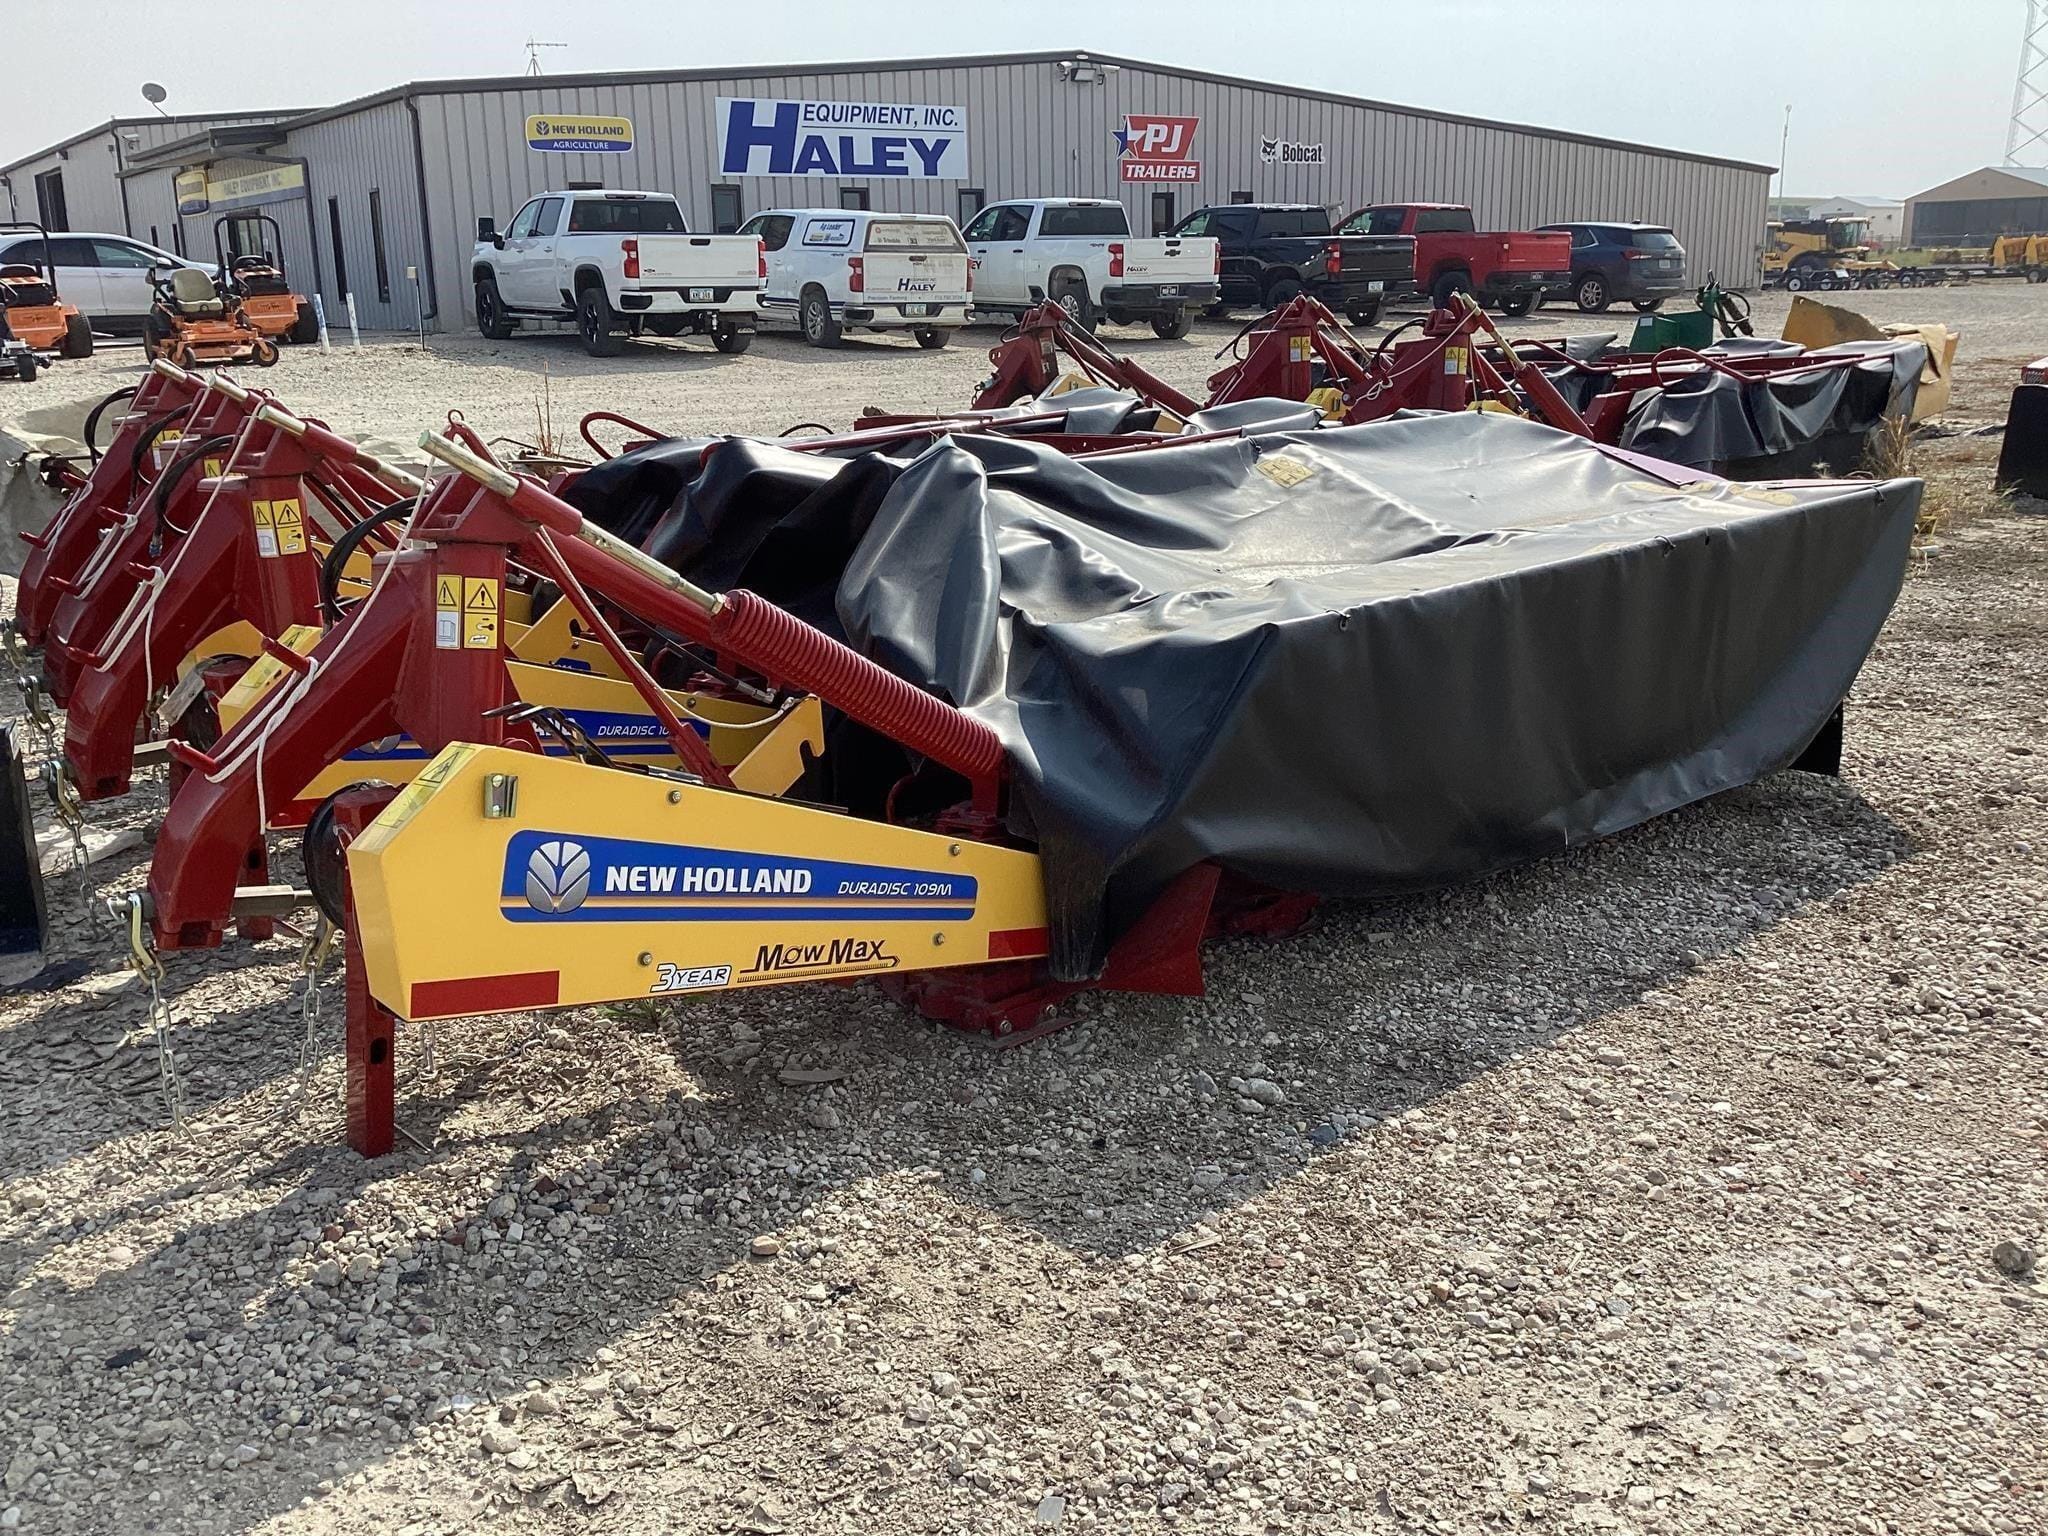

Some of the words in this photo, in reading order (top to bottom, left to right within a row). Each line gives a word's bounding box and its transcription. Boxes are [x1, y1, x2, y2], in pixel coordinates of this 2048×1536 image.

[803, 103, 918, 128] EQUIPMENT,
[924, 108, 958, 126] INC.
[552, 125, 576, 134] NEW
[578, 126, 624, 135] HOLLAND
[723, 101, 951, 176] HALEY
[1143, 124, 1183, 153] PJ
[553, 141, 609, 149] AGRICULTURE
[1282, 143, 1323, 162] Bobcat
[1126, 164, 1197, 179] TRAILERS
[898, 278, 936, 291] HALEY
[598, 725, 656, 736] DURADISC
[605, 866, 677, 892] NEW
[682, 867, 812, 893] HOLLAND
[838, 881, 911, 895] DURADISC
[913, 883, 952, 896] 109M
